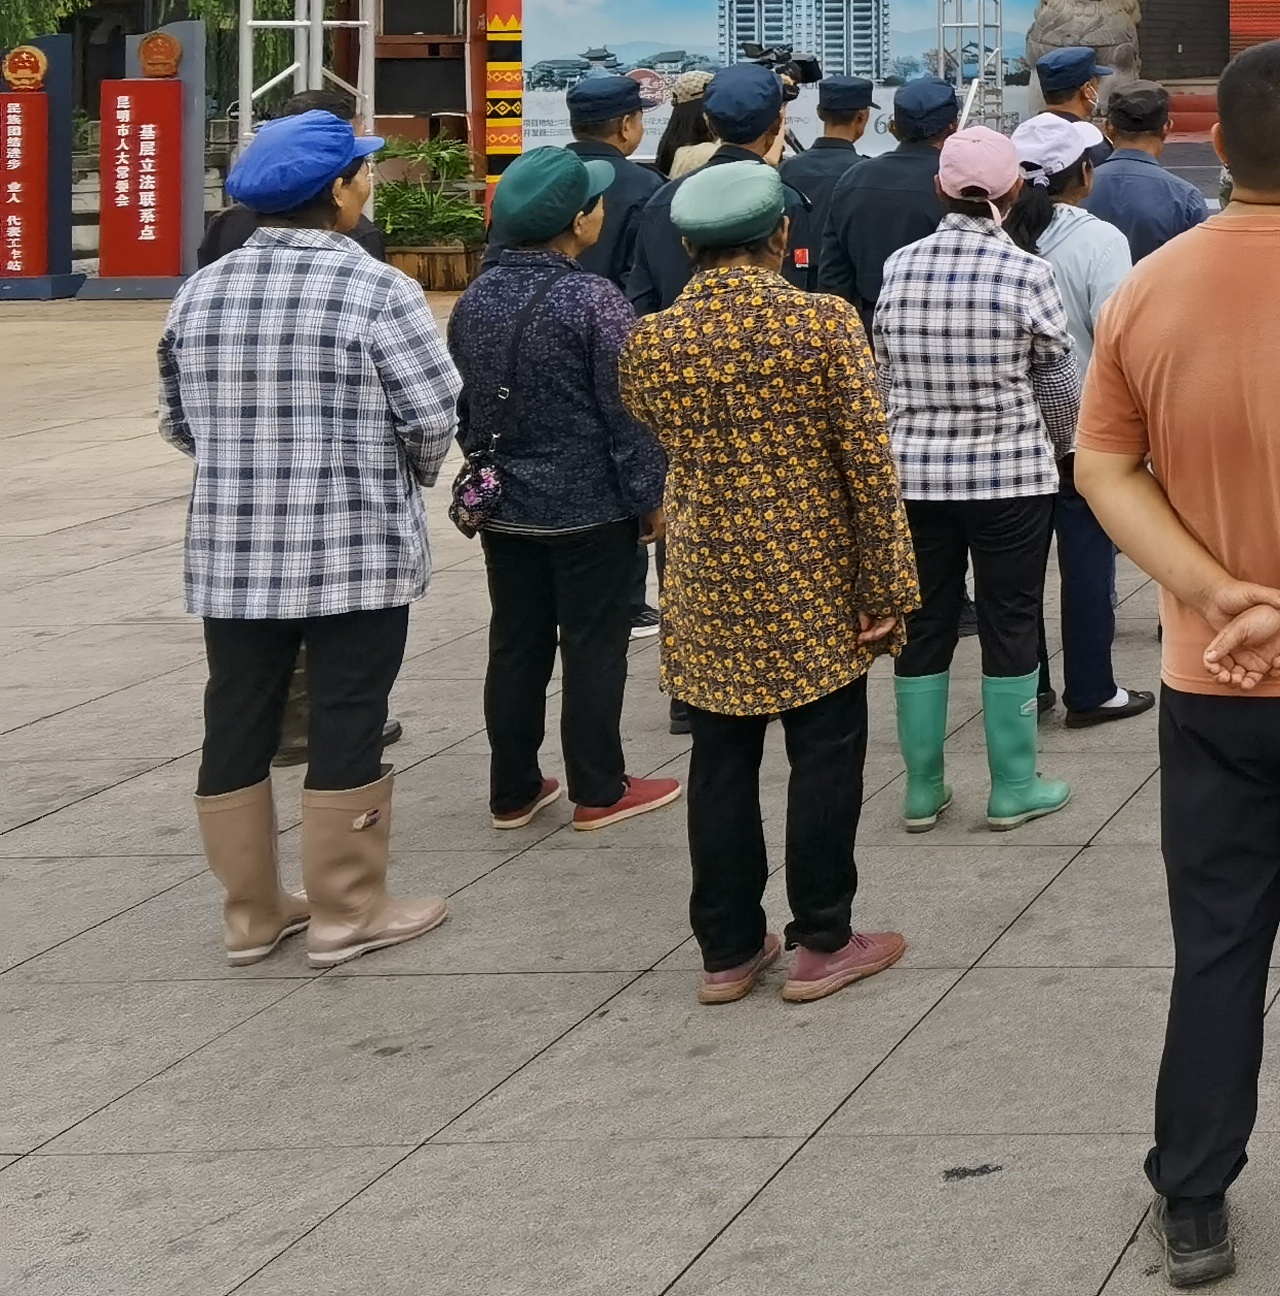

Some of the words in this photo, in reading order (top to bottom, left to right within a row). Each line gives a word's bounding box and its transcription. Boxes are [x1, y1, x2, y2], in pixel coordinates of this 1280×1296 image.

[114, 95, 131, 207] 昆明市人大常委会
[138, 124, 157, 241] 基层立法联系点
